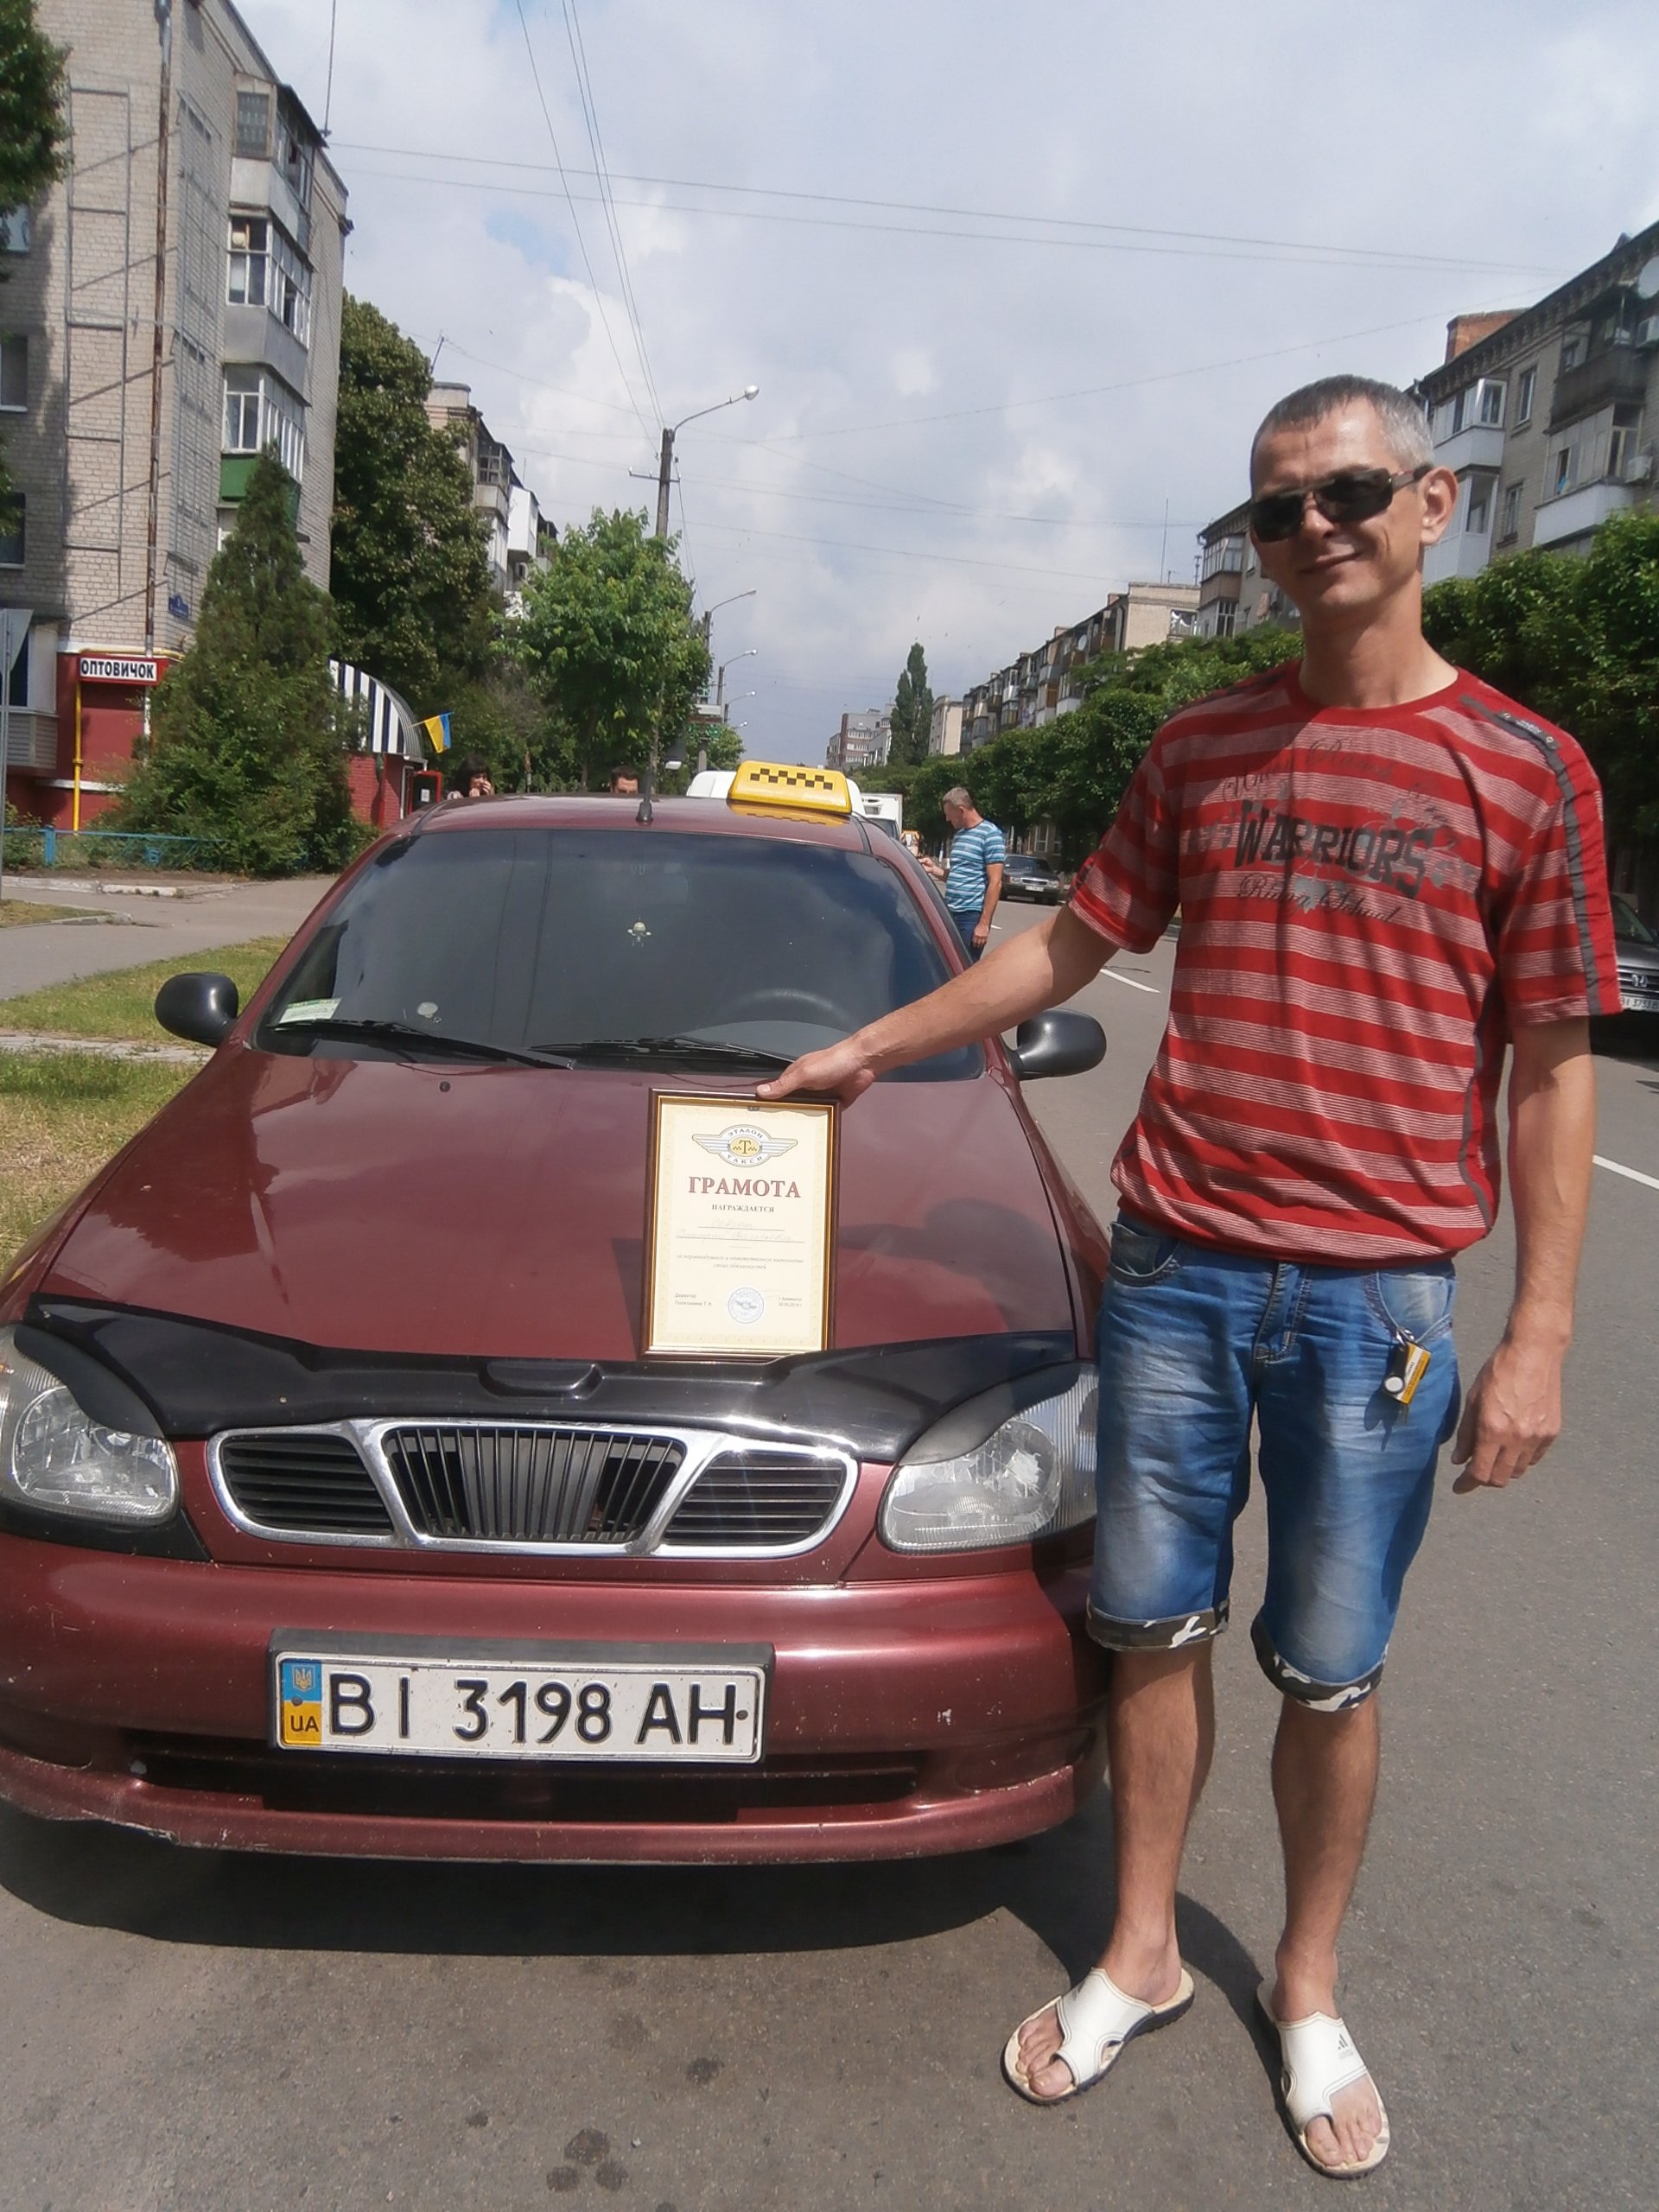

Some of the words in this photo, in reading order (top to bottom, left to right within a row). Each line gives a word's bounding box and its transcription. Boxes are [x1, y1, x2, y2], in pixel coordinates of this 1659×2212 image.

[80, 659, 154, 679] ОПТОВИЧОК
[1234, 798, 1435, 899] WARRIORS
[727, 1128, 764, 1139] ЭТАЛОН
[727, 1154, 764, 1165] ТАКСИ
[688, 1175, 802, 1198] ГРАМОТА
[711, 1204, 775, 1213] НАГРАЖДАЕТСЯ
[329, 1671, 410, 1738] BI
[452, 1677, 613, 1745] 3198
[635, 1681, 735, 1745] AH
[289, 1714, 320, 1732] UA
